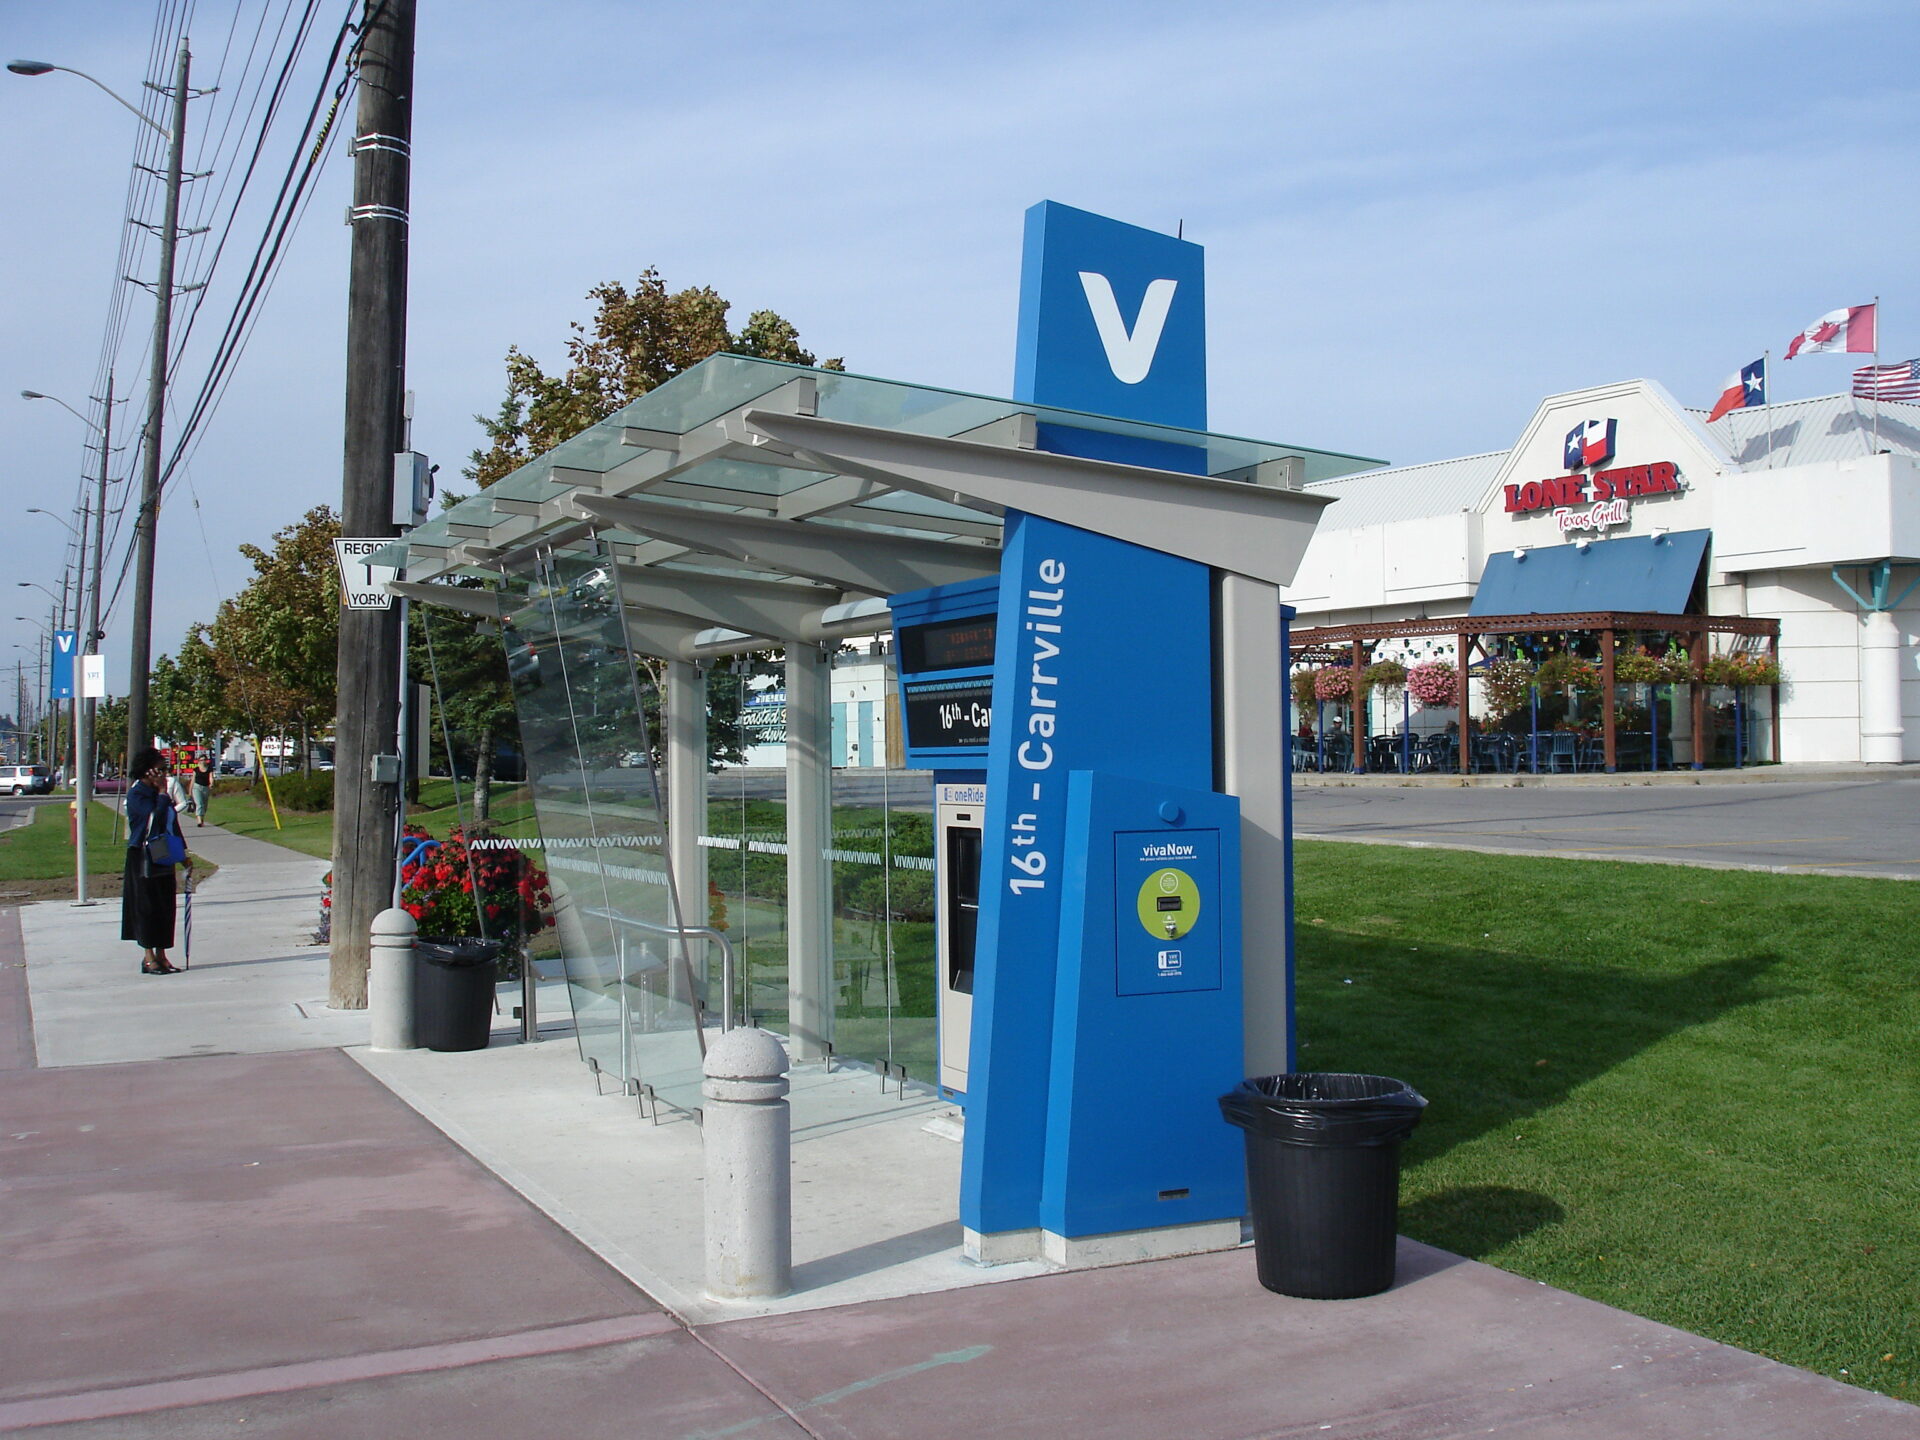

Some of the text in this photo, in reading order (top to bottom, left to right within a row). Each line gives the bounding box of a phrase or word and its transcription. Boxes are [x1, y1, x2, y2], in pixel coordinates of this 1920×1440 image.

[1078, 271, 1178, 385] V
[1504, 461, 1681, 513] LONE STAR
[1554, 500, 1623, 531] Texas Grill
[344, 543, 388, 555] REGIO
[351, 593, 386, 605] YORK
[57, 635, 73, 653] V
[1016, 558, 1066, 770] Carrville
[939, 702, 962, 729] 16th
[954, 787, 984, 802] oneRide
[1009, 813, 1047, 895] 16th
[1142, 843, 1193, 857] vivaNow
